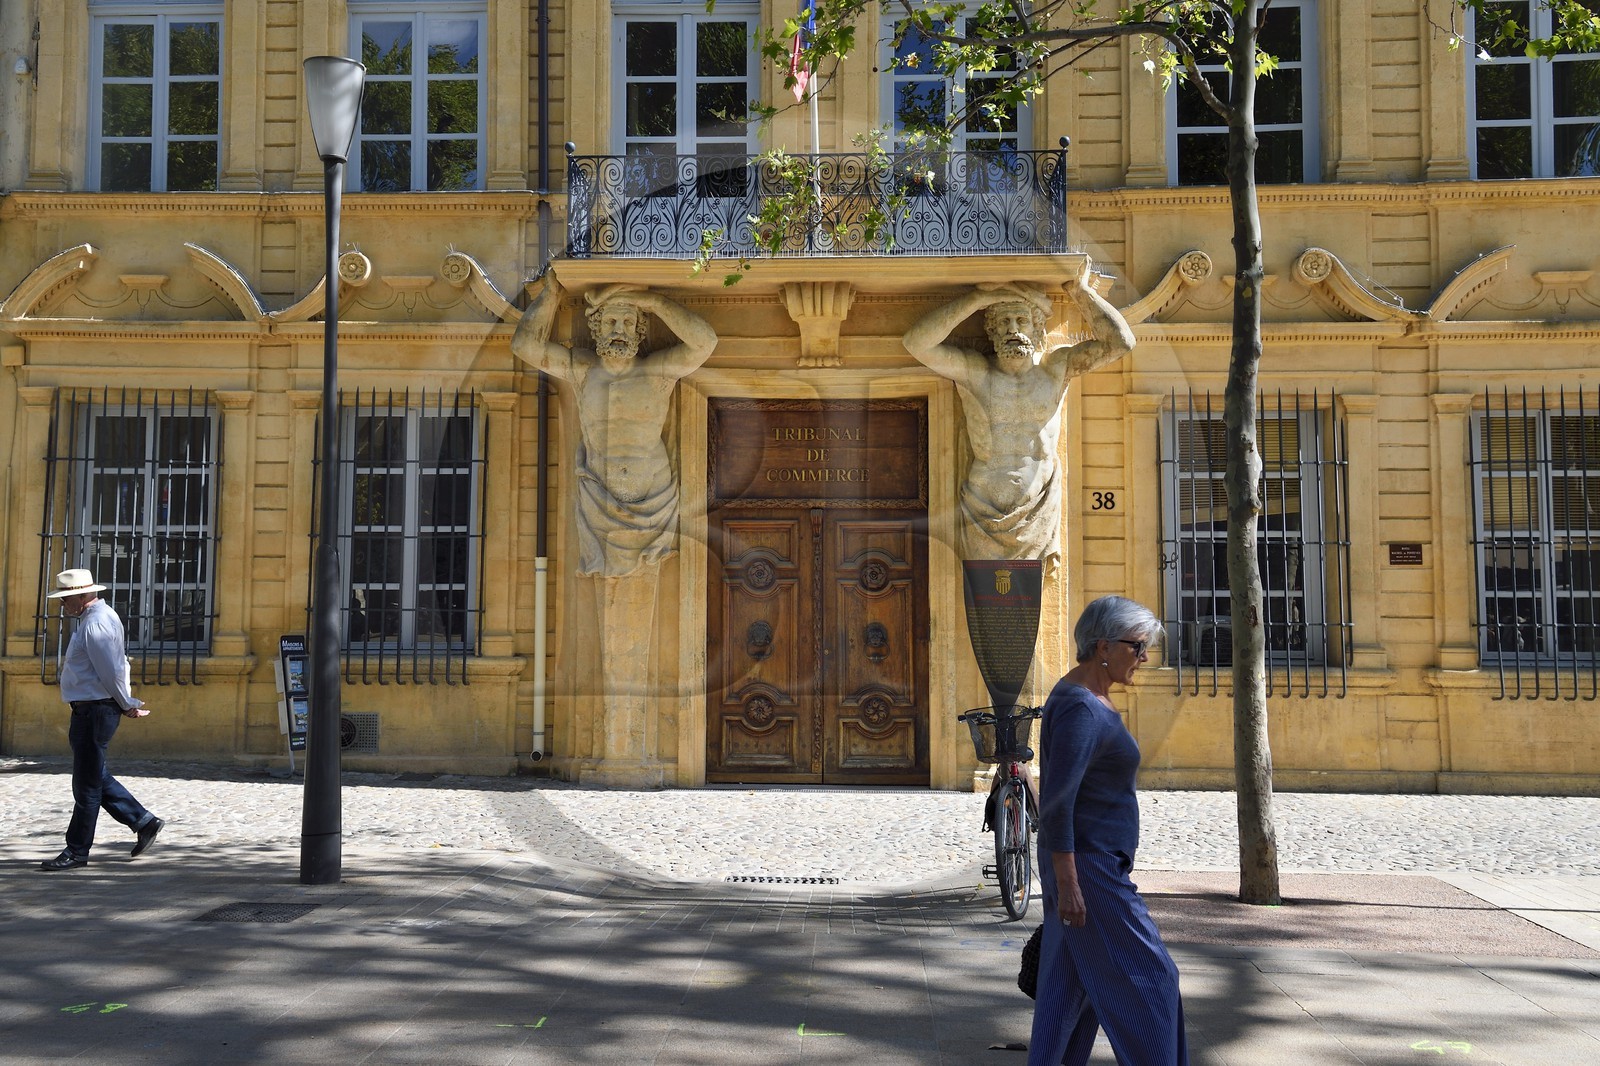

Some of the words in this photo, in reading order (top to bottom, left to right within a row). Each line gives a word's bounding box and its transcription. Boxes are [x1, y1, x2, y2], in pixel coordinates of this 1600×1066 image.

[771, 427, 865, 441] TRIBUNAL
[806, 449, 830, 462] DE
[766, 468, 870, 482] COMMERCE
[1091, 491, 1116, 510] 38
